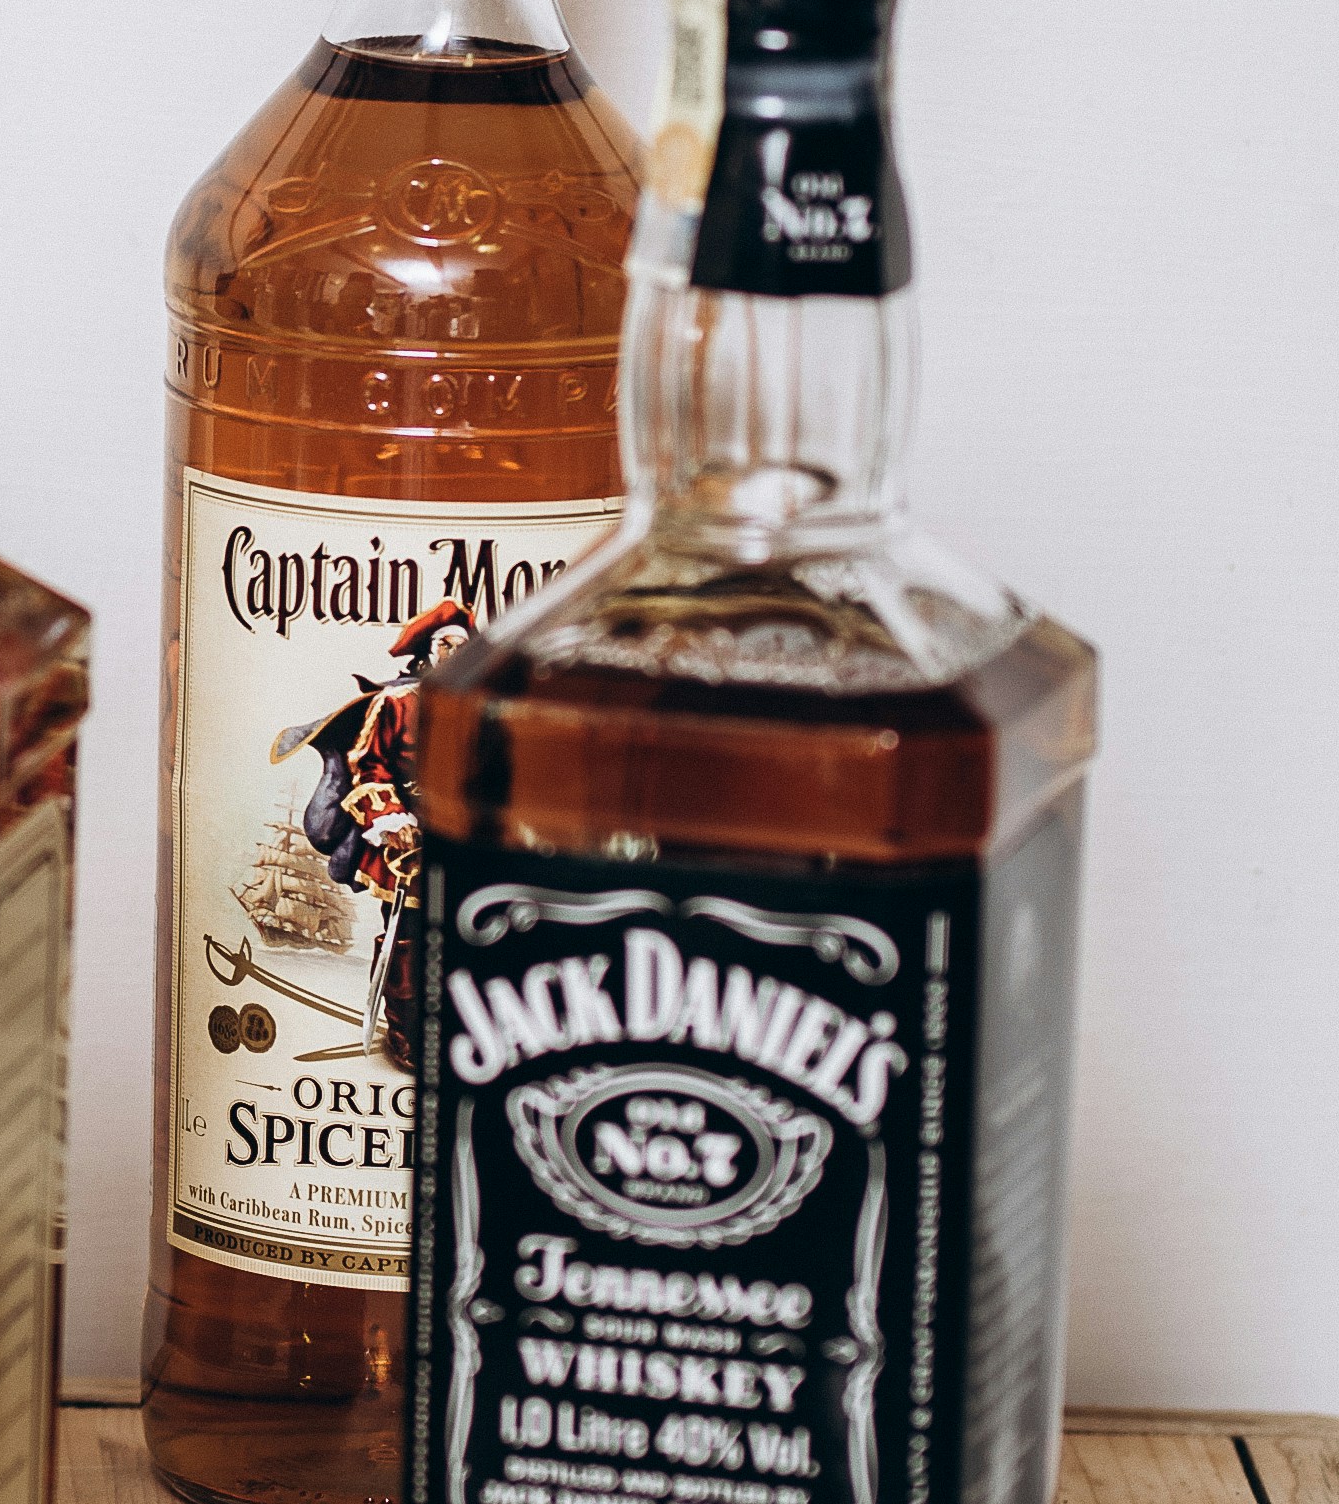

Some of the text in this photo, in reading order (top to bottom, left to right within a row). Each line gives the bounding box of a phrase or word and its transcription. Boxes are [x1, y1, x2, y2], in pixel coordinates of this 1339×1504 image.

[221, 525, 421, 637] Captain
[448, 927, 910, 1127] JACK DANIEL'S
[188, 1183, 216, 1206] with
[220, 1191, 302, 1225] Caribbean
[289, 1181, 408, 1210] A PREMIUM
[193, 1223, 293, 1262] PRODUCED
[300, 1249, 335, 1267] BY
